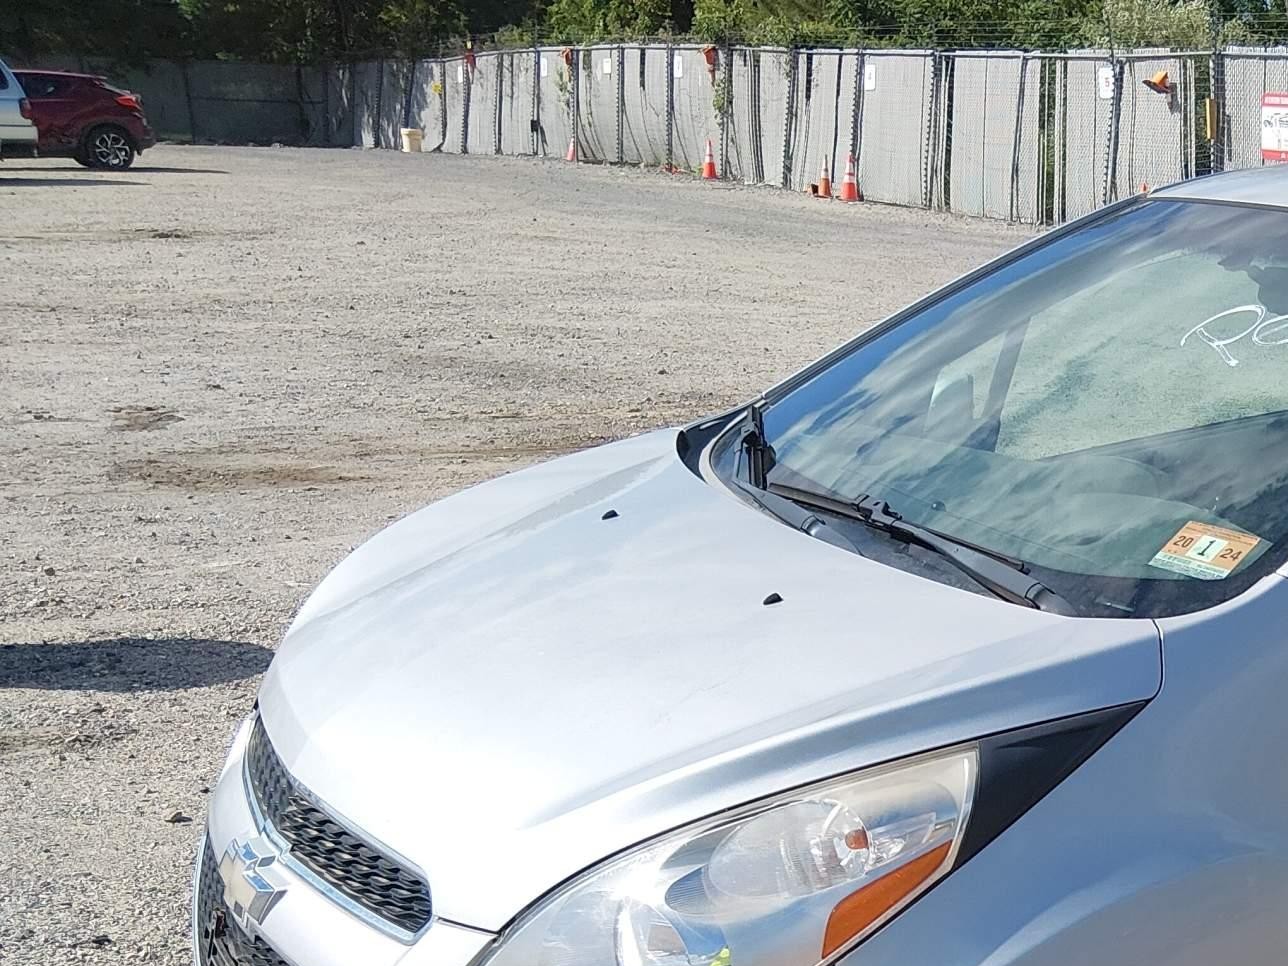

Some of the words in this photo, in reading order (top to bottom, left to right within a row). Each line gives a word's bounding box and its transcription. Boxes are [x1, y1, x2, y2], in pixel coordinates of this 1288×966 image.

[1173, 535, 1194, 548] 20
[1197, 539, 1212, 556] 1
[1220, 548, 1242, 561] 24
